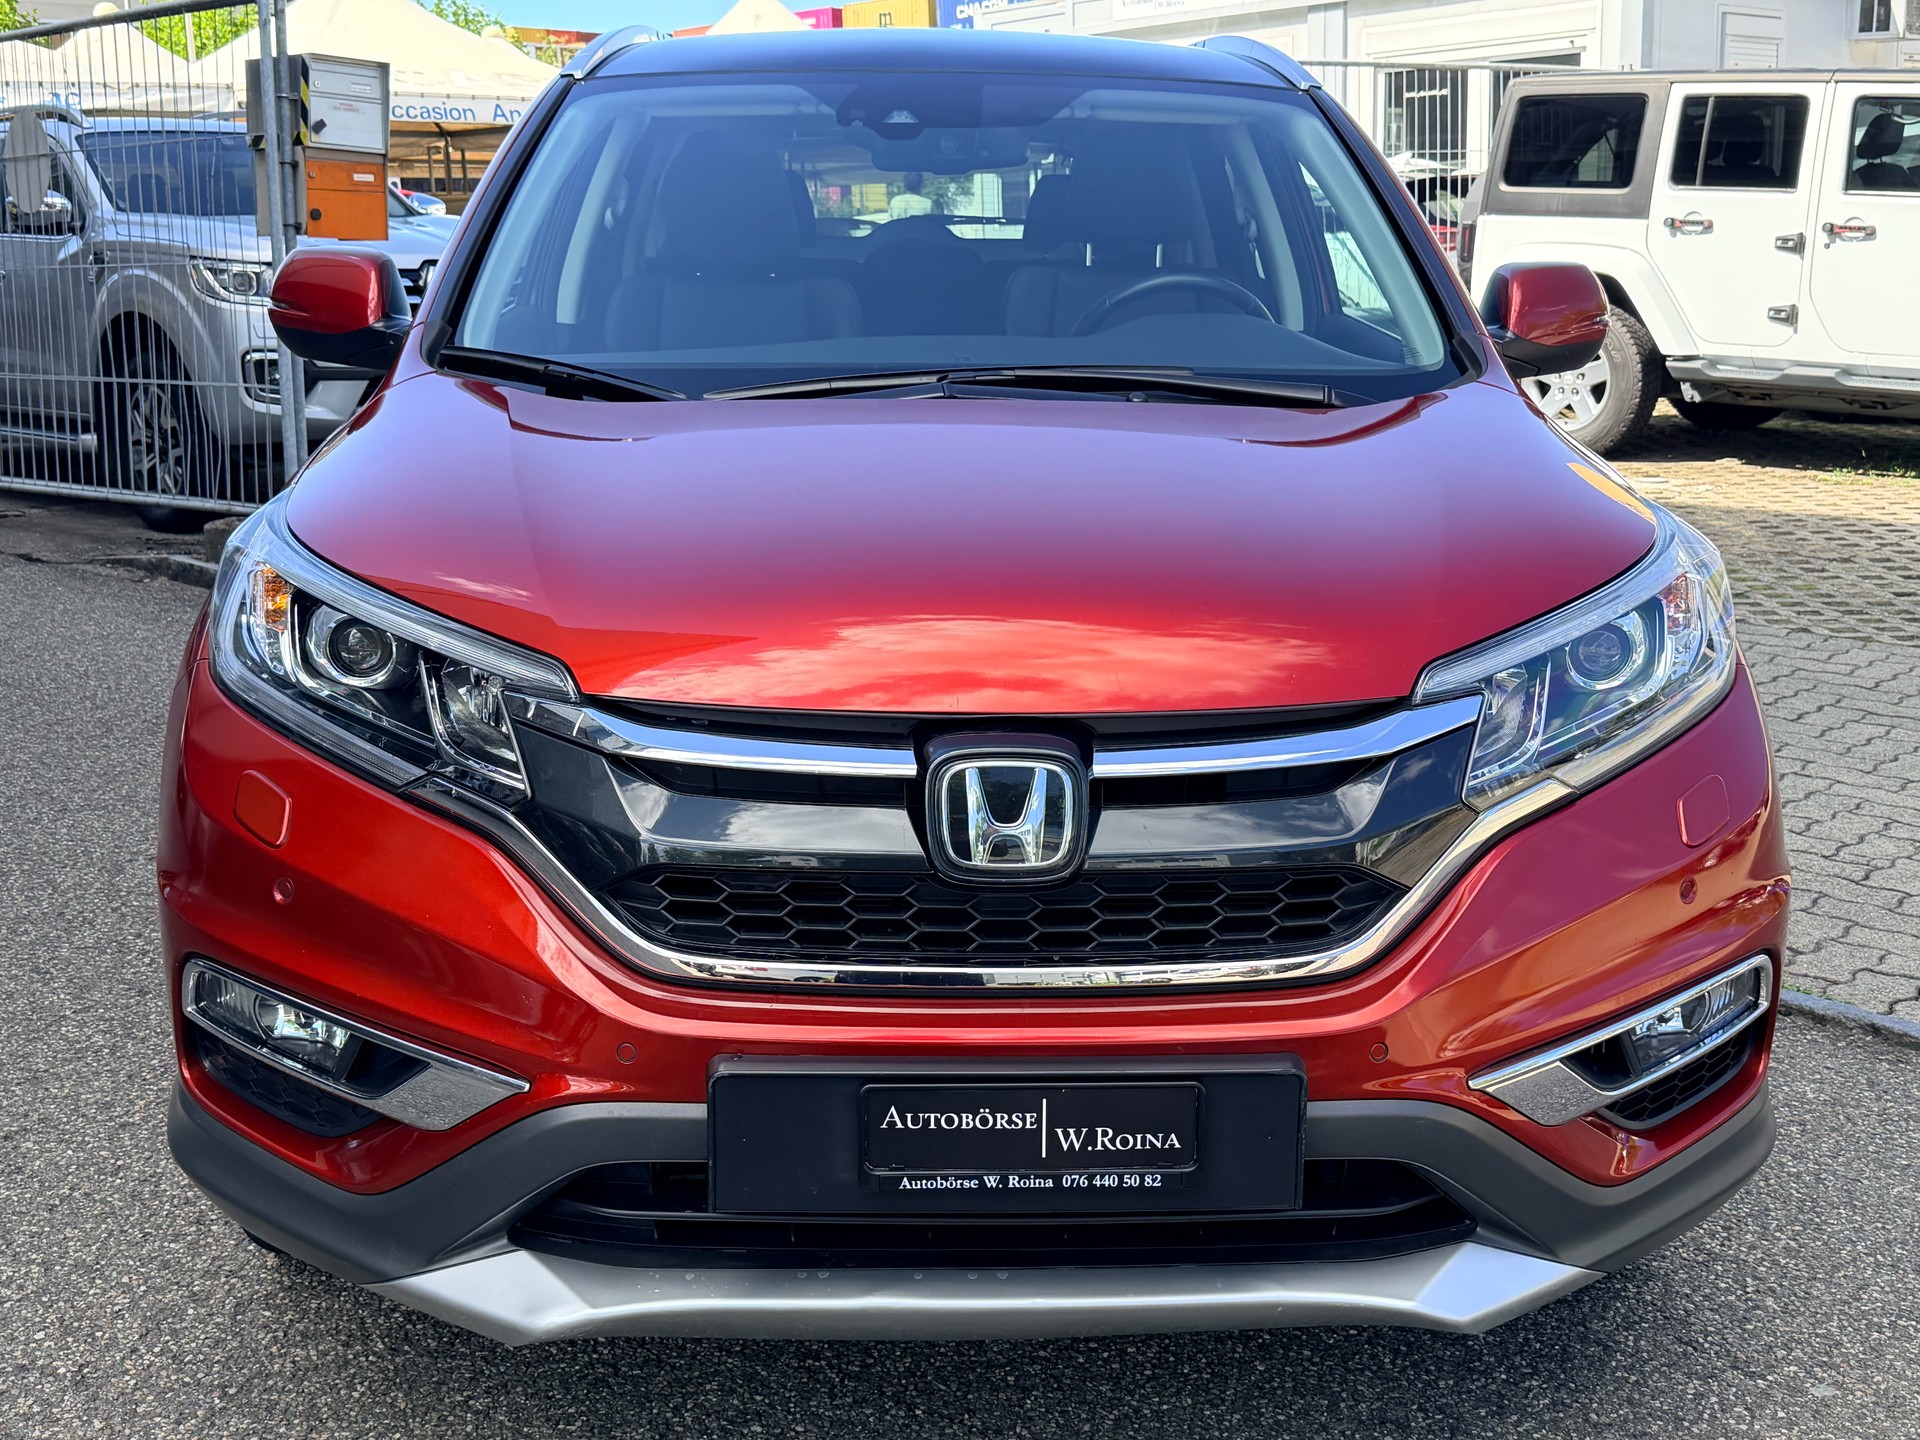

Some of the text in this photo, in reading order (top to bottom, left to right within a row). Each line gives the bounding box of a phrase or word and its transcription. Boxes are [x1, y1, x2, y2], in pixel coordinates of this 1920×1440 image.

[391, 101, 522, 124] ccasion An
[879, 1105, 1038, 1130] AUTOBÖRSE
[898, 1174, 1162, 1190] Autobörse W. Roina 076 440 50 82
